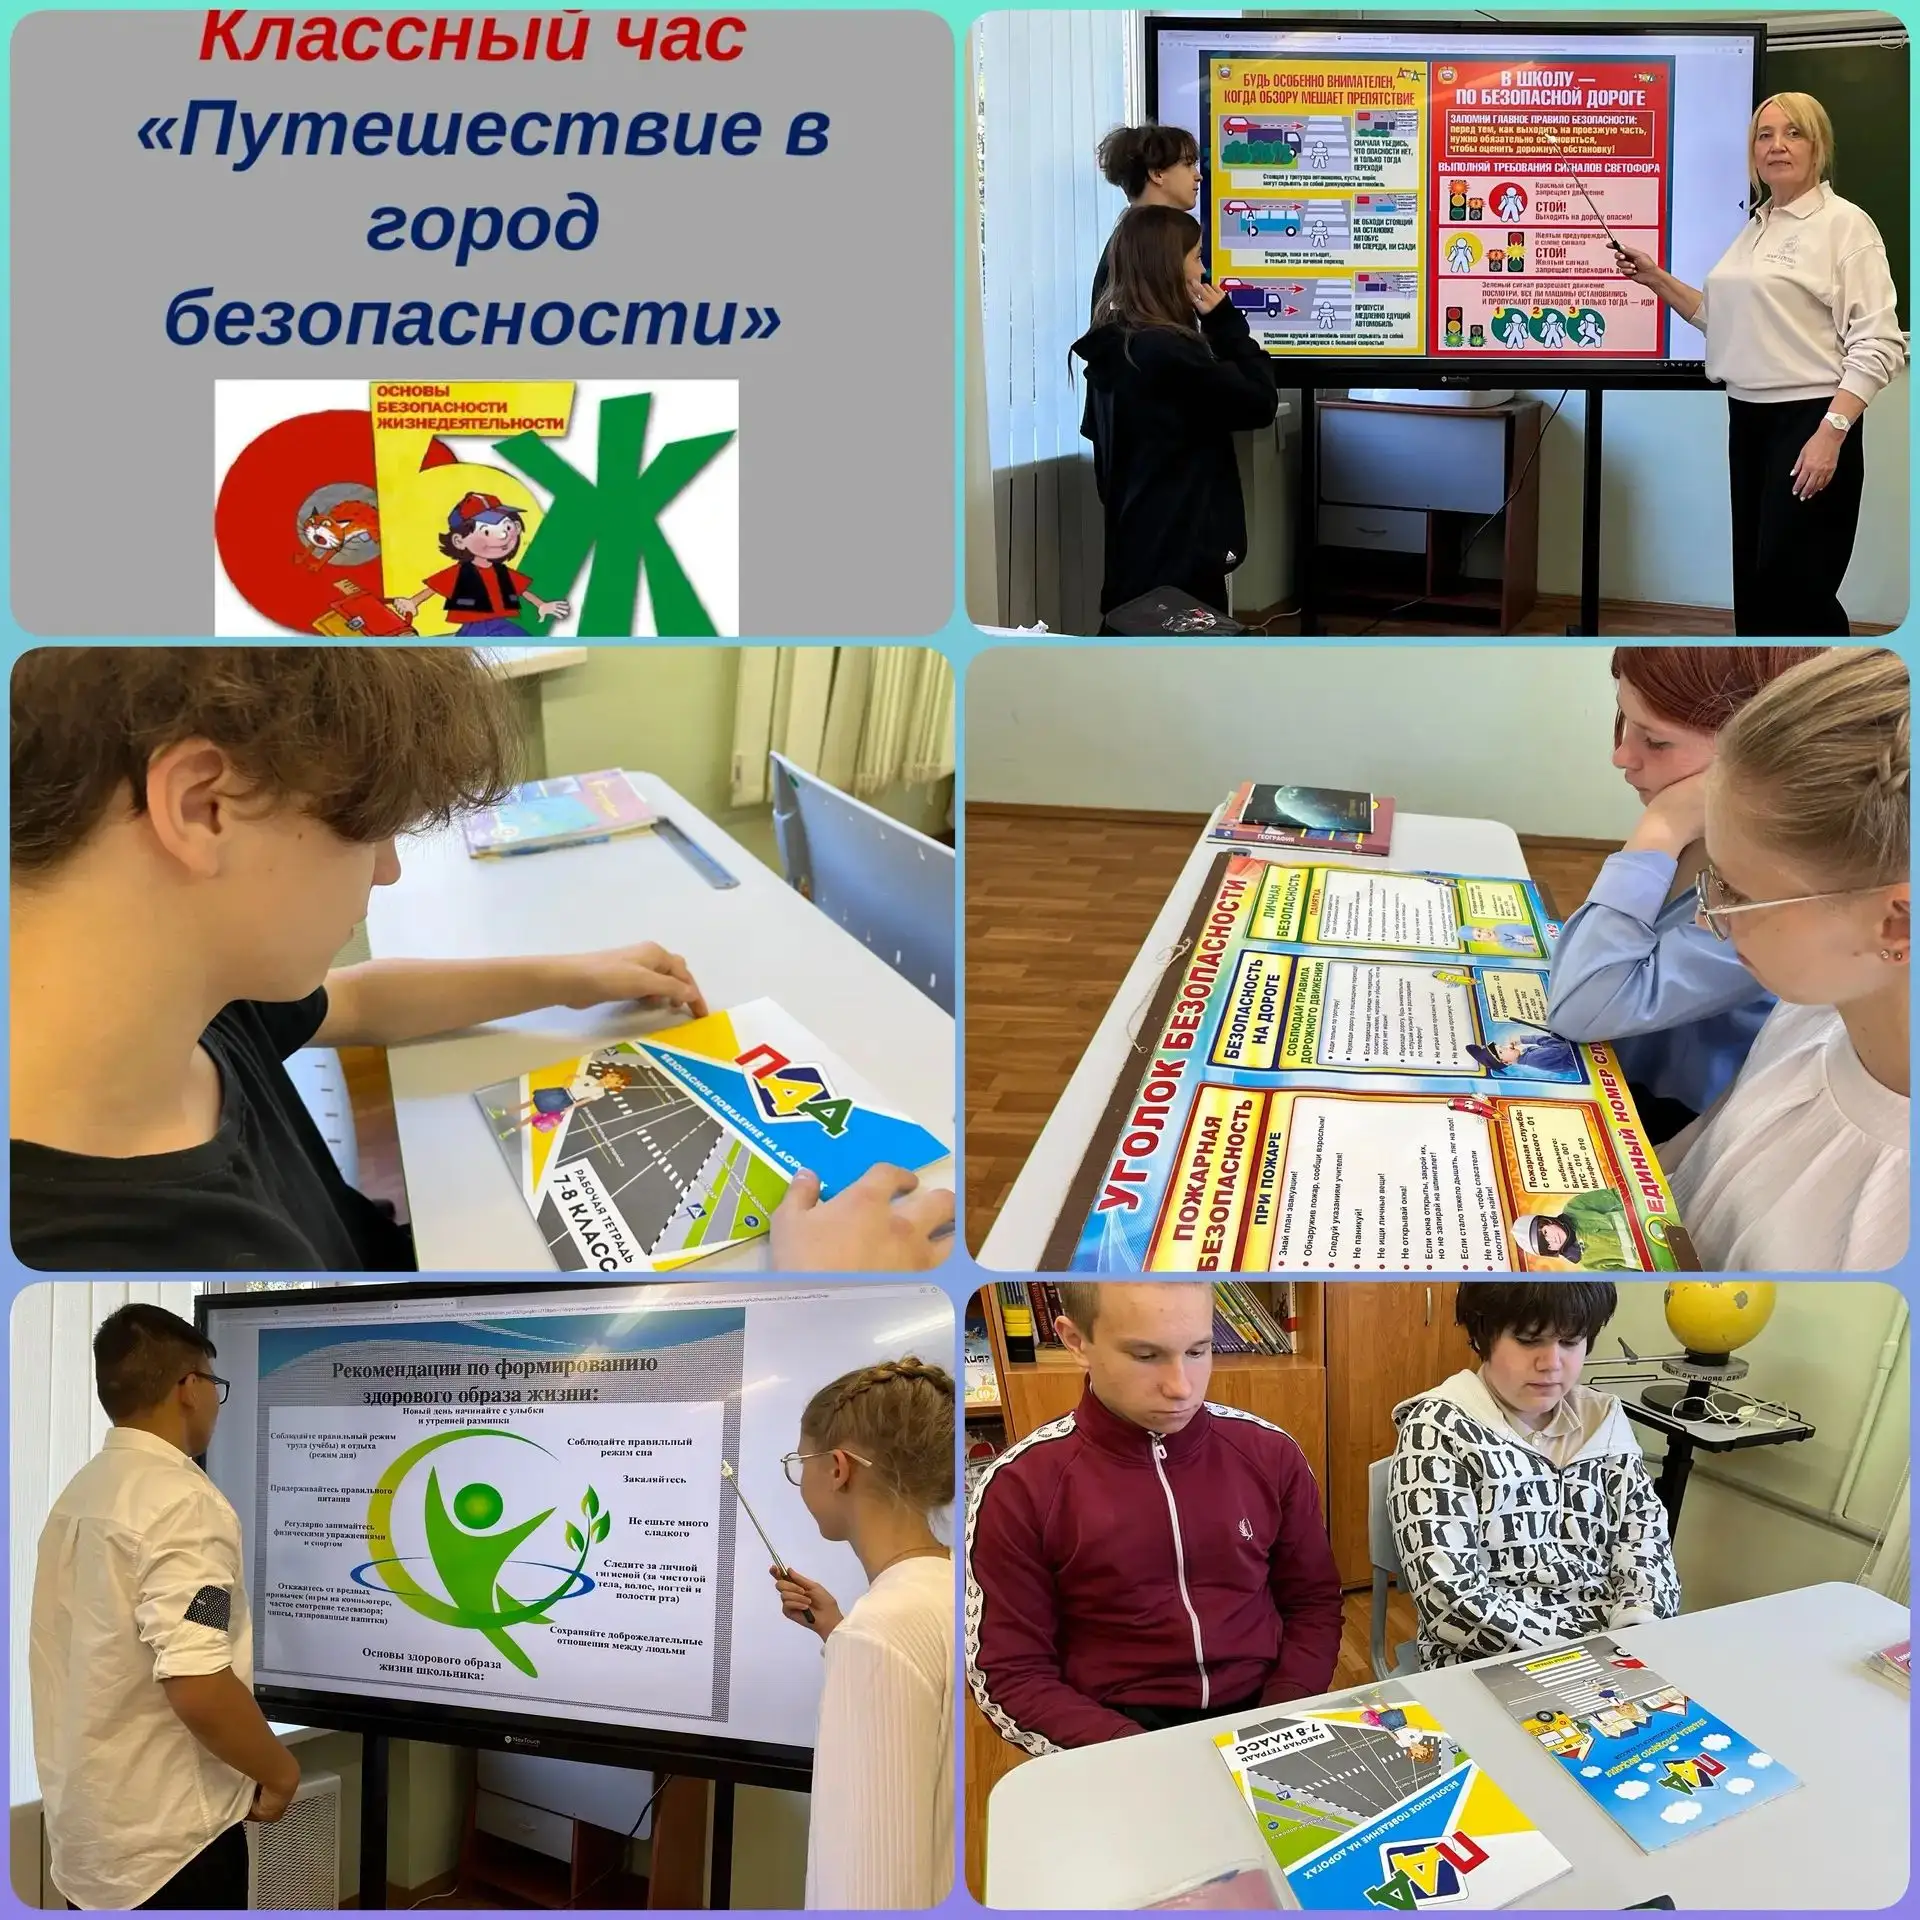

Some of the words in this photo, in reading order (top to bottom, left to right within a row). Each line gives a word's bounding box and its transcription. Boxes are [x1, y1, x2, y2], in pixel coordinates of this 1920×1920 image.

[199, 11, 587, 62] Классный
[615, 15, 746, 62] час
[1244, 74, 1270, 87] БУДЬ
[1274, 75, 1324, 88] ОСОБЕННО
[1328, 76, 1395, 90] ВНИМАТЕЛЕН,
[1501, 71, 1511, 86] В
[1517, 71, 1573, 87] ШКОЛУ
[1224, 90, 1256, 104] КОГДА
[1260, 91, 1298, 104] ОБЗОРУ
[1302, 92, 1344, 105] МЕШАЕТ
[1348, 93, 1415, 105] ПРЕПЯТСТВИЕ
[1456, 89, 1477, 105] ПО
[1482, 86, 1582, 106] БЕЗОПАСНОЙ
[1587, 90, 1645, 108] ДОРОГЕ
[1451, 114, 1490, 124] ЗАПОМНИ
[1493, 115, 1529, 124] ГЛАВНОЕ
[1531, 115, 1569, 124] ПРАВИЛО
[1572, 115, 1637, 125] БЕЗОПАСНОСТИ:
[137, 100, 761, 171] «Путешествие
[786, 110, 830, 156] в
[1451, 126, 1475, 135] перед
[1478, 126, 1496, 135] тем,
[1517, 127, 1557, 135] выходить
[1572, 127, 1617, 136] проезжую
[1620, 128, 1647, 136] часть,
[1451, 136, 1477, 144] нужно
[1480, 135, 1533, 144] обязательно
[1360, 156, 1382, 164] ТОЛЬКО
[1384, 156, 1401, 164] ТОГДА
[1368, 148, 1400, 156] ОПАСНОСТИ
[1451, 145, 1477, 153] чтобы
[1480, 145, 1514, 154] оценить
[1517, 145, 1560, 155] дорожную
[1563, 145, 1615, 155] обстановку!
[1354, 164, 1383, 172] ПЕРЕХОДИ
[1438, 161, 1490, 172] ВЫПОЛНЯЙ
[1494, 163, 1551, 172] ТРЕБОВАНИЯ
[1555, 163, 1602, 173] СИГНАЛОВ
[1605, 164, 1660, 173] СВЕТОФОРА
[1536, 201, 1566, 212] СТОЙ!
[366, 193, 600, 266] город
[1354, 218, 1361, 226] НЕ
[1362, 218, 1384, 227] ОБХОДИ
[1386, 218, 1413, 227] СТОЯЩИЙ
[1398, 243, 1416, 251] СЗАДИ
[1536, 247, 1566, 258] СТОЙ!
[164, 287, 782, 347] безопасности»
[1355, 304, 1384, 312] ПРОПУСТИ
[1355, 312, 1385, 320] МЕДЛЕННО
[1387, 311, 1410, 320] ЕДУЩИЙ
[1355, 320, 1393, 328] АВТОМОБИЛЬ
[377, 386, 449, 398] ОСНОВЫ
[377, 401, 508, 413] БЕЗОПАСНОСТИ
[377, 417, 564, 431] ЖИЗНЕДЕЯТЕЛЬНОСТИ
[1258, 834, 1295, 842] ГЕОГРАФИЯ
[1264, 884, 1281, 918] ЛИЧНАЯ
[1277, 873, 1300, 937] БЕЗОПАСНОСТЬ
[1310, 888, 1321, 915] ПАМЯТКА
[1224, 959, 1263, 1059] БЕЗОПАСНОСТЬ
[1258, 974, 1280, 1023] ДОРОГЕ
[1286, 1012, 1304, 1056] СОБЛЮДАЙ
[1296, 967, 1310, 1011] ПРАВИЛА
[1301, 1006, 1318, 1064] ДОРОЖНОГО
[1312, 962, 1324, 1007] ДВИЖЕНИЯ
[1098, 1060, 1186, 1210] УГОЛОК
[1163, 879, 1247, 1050] БЕЗОПАСНОСТИ
[1252, 1024, 1267, 1045] НА
[734, 1043, 853, 1139] ПДД
[1599, 1068, 1631, 1124] НОМЕР
[661, 1054, 714, 1097] БЕЗОПАСНОЕ
[711, 1092, 764, 1142] ПОВЕДЕНИЕ
[763, 1137, 779, 1151] НА
[1516, 1109, 1528, 1141] служба:
[1527, 1116, 1535, 1125] 01
[1317, 1116, 1325, 1152] взрослым!
[1261, 1132, 1281, 1189] ПОЖАРЕ
[1313, 1154, 1322, 1180] сообщи
[1524, 1142, 1538, 1188] Пожарная
[1533, 1135, 1547, 1181] городского
[1173, 1116, 1222, 1240] ПОЖАРНАЯ
[1618, 1128, 1665, 1214] ЕДИНЫЙ
[1197, 1100, 1253, 1272] БЕЗОПАСНОСТЬ
[1287, 1171, 1298, 1211] эвакуации!
[1311, 1183, 1320, 1208] пожар,
[575, 1169, 607, 1214] РАБОЧАЯ
[602, 1216, 633, 1263] ТЕТРАДЬ
[1254, 1194, 1271, 1225] ПРИ
[554, 1175, 578, 1200] 7-8
[569, 1203, 618, 1272] КЛАСС
[1284, 1214, 1292, 1233] план
[1304, 1210, 1316, 1256] Обнаружив
[1355, 1209, 1364, 1244] паникуй!
[1401, 1205, 1410, 1246] открывай
[1279, 1235, 1289, 1255] Знай
[1329, 1225, 1340, 1257] Следуй
[1353, 1247, 1361, 1258] Не
[1401, 1248, 1409, 1259] Не
[333, 1362, 461, 1380] Рекомендации
[467, 1363, 489, 1376] по
[495, 1357, 658, 1379] формированию
[363, 1390, 453, 1406] здорового
[458, 1386, 522, 1405] образа
[527, 1387, 600, 1402] жизни:
[568, 1438, 625, 1447] Соблюдайте
[628, 1438, 692, 1448] правильный
[600, 1449, 633, 1458] режим
[622, 1475, 687, 1484] Закаляйтесь
[629, 1517, 642, 1525] Не
[678, 1520, 709, 1528] много
[645, 1529, 690, 1538] сладкого
[550, 1626, 605, 1638] Сохраняйте
[608, 1632, 703, 1646] доброжелательные
[557, 1638, 609, 1649] отношения
[612, 1643, 643, 1652] между
[645, 1646, 686, 1655] людьми
[362, 1648, 404, 1660] Основы
[407, 1653, 461, 1666] здорового
[464, 1658, 501, 1669] образа
[379, 1663, 413, 1673] жизни
[416, 1666, 485, 1681] школьника:
[1235, 1727, 1294, 1756] КЛАСС
[1296, 1724, 1320, 1738] 7-8
[1282, 1733, 1325, 1751] РАБОЧАЯ
[1241, 1744, 1284, 1762] ТЕТРАДЬ
[1656, 1752, 1728, 1796] ПДД
[1408, 1780, 1460, 1814] БЕЗОПАСНОЕ
[1360, 1810, 1410, 1844] ПОВЕДЕНИЕ
[1347, 1840, 1361, 1853] НА
[1303, 1847, 1346, 1879] ДОРОГАХ
[1364, 1830, 1490, 1910] ПДД
